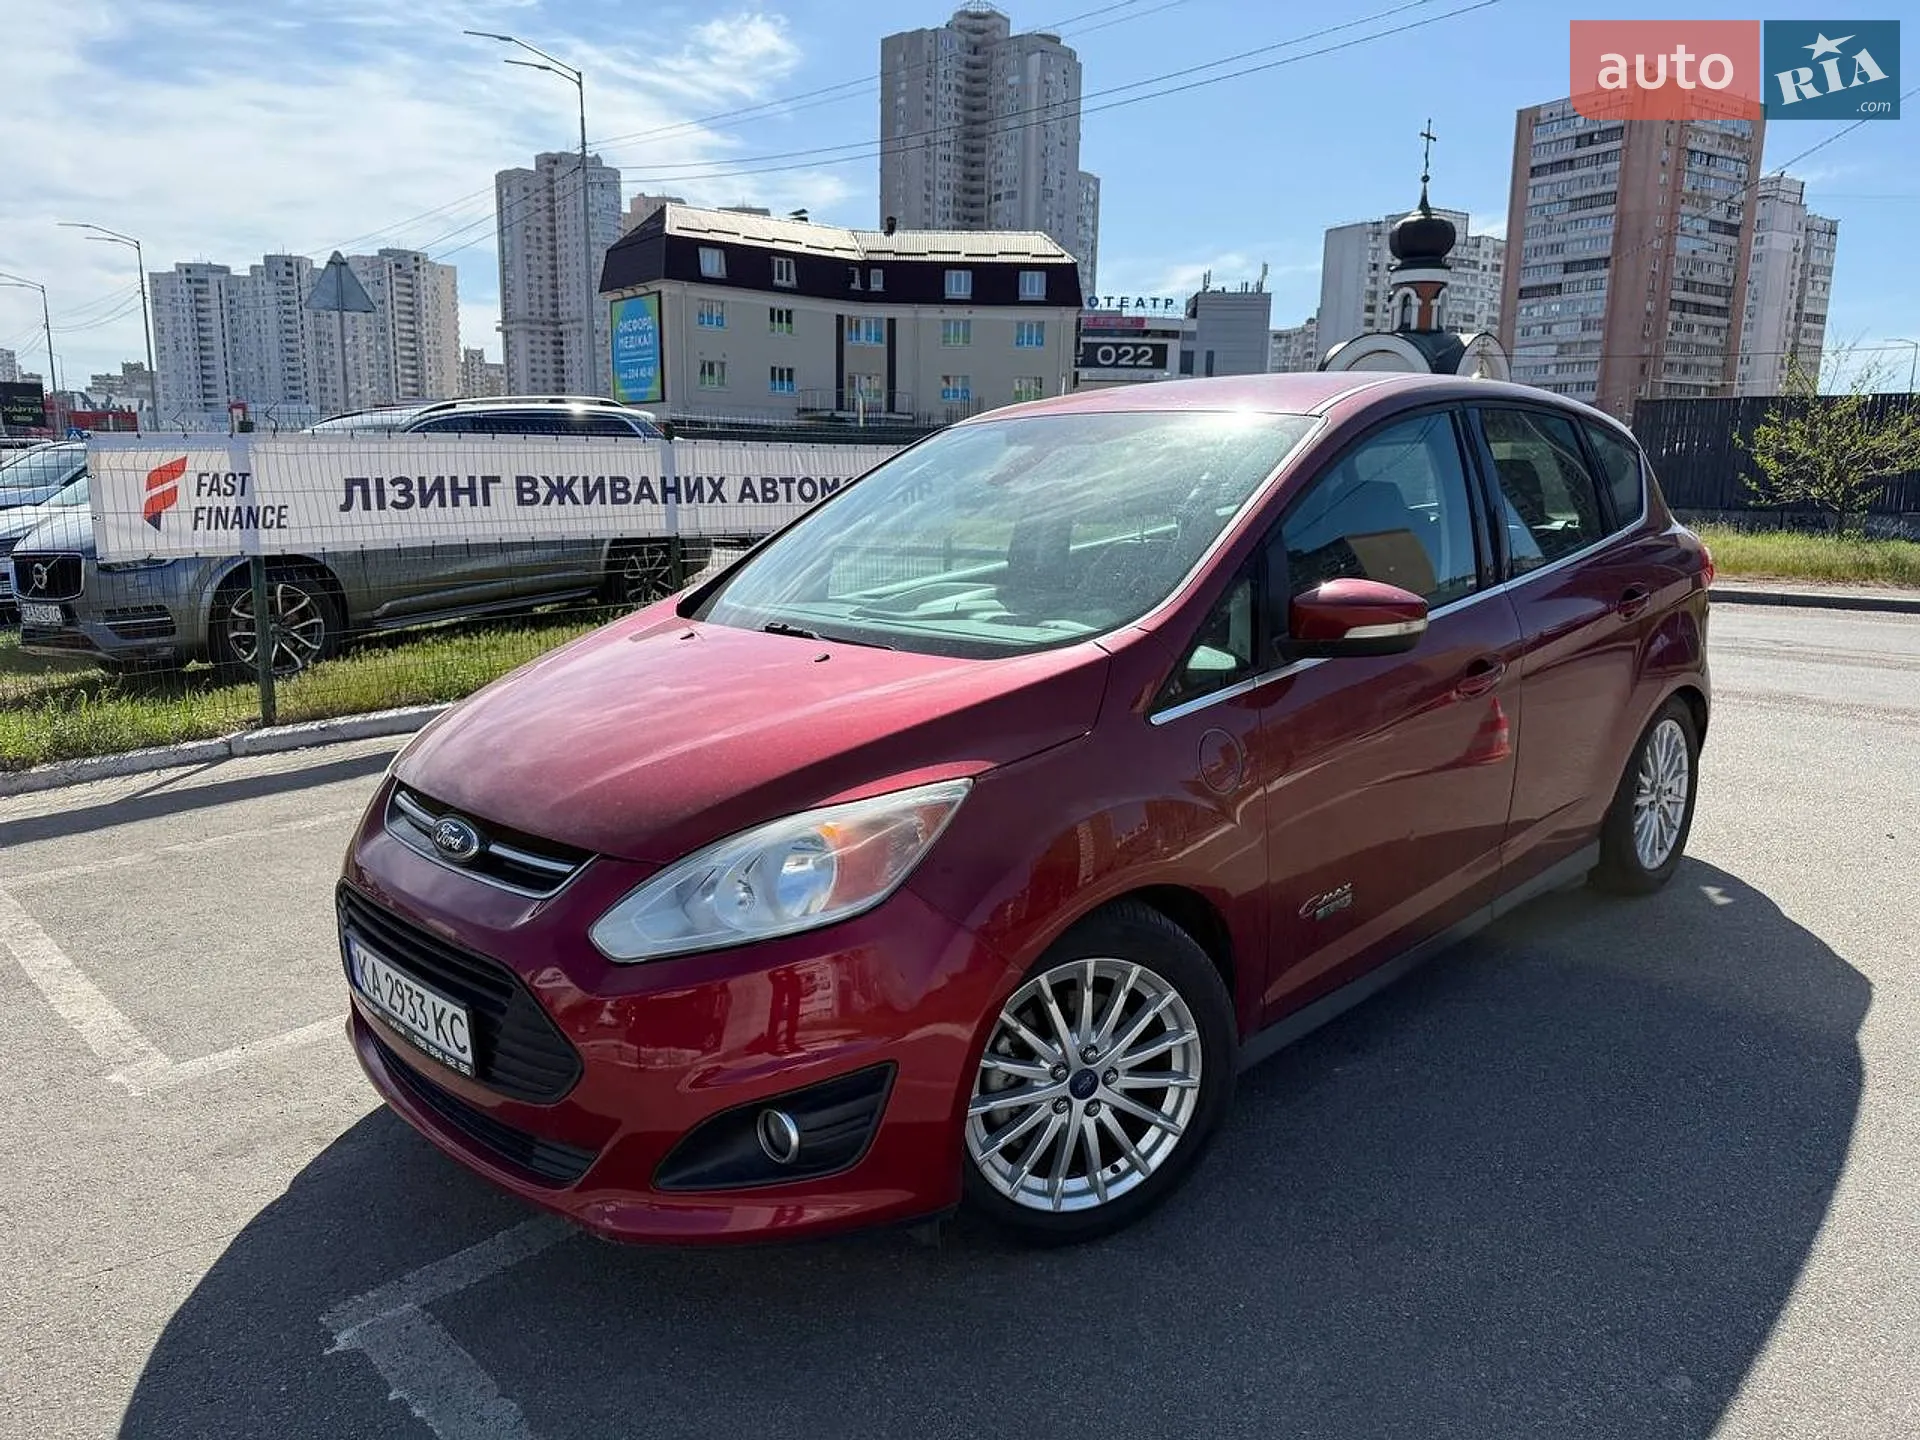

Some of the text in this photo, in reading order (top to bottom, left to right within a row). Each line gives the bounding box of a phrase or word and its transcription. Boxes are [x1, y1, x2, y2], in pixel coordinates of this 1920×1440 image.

[195, 472, 251, 497] FAST
[339, 475, 503, 512] ЛІЗИНГ
[514, 475, 729, 507] ВЖИВАНИХ
[193, 504, 289, 532] FINANCE
[437, 822, 464, 850] Ford
[356, 950, 468, 1054] KA 2933 KC
